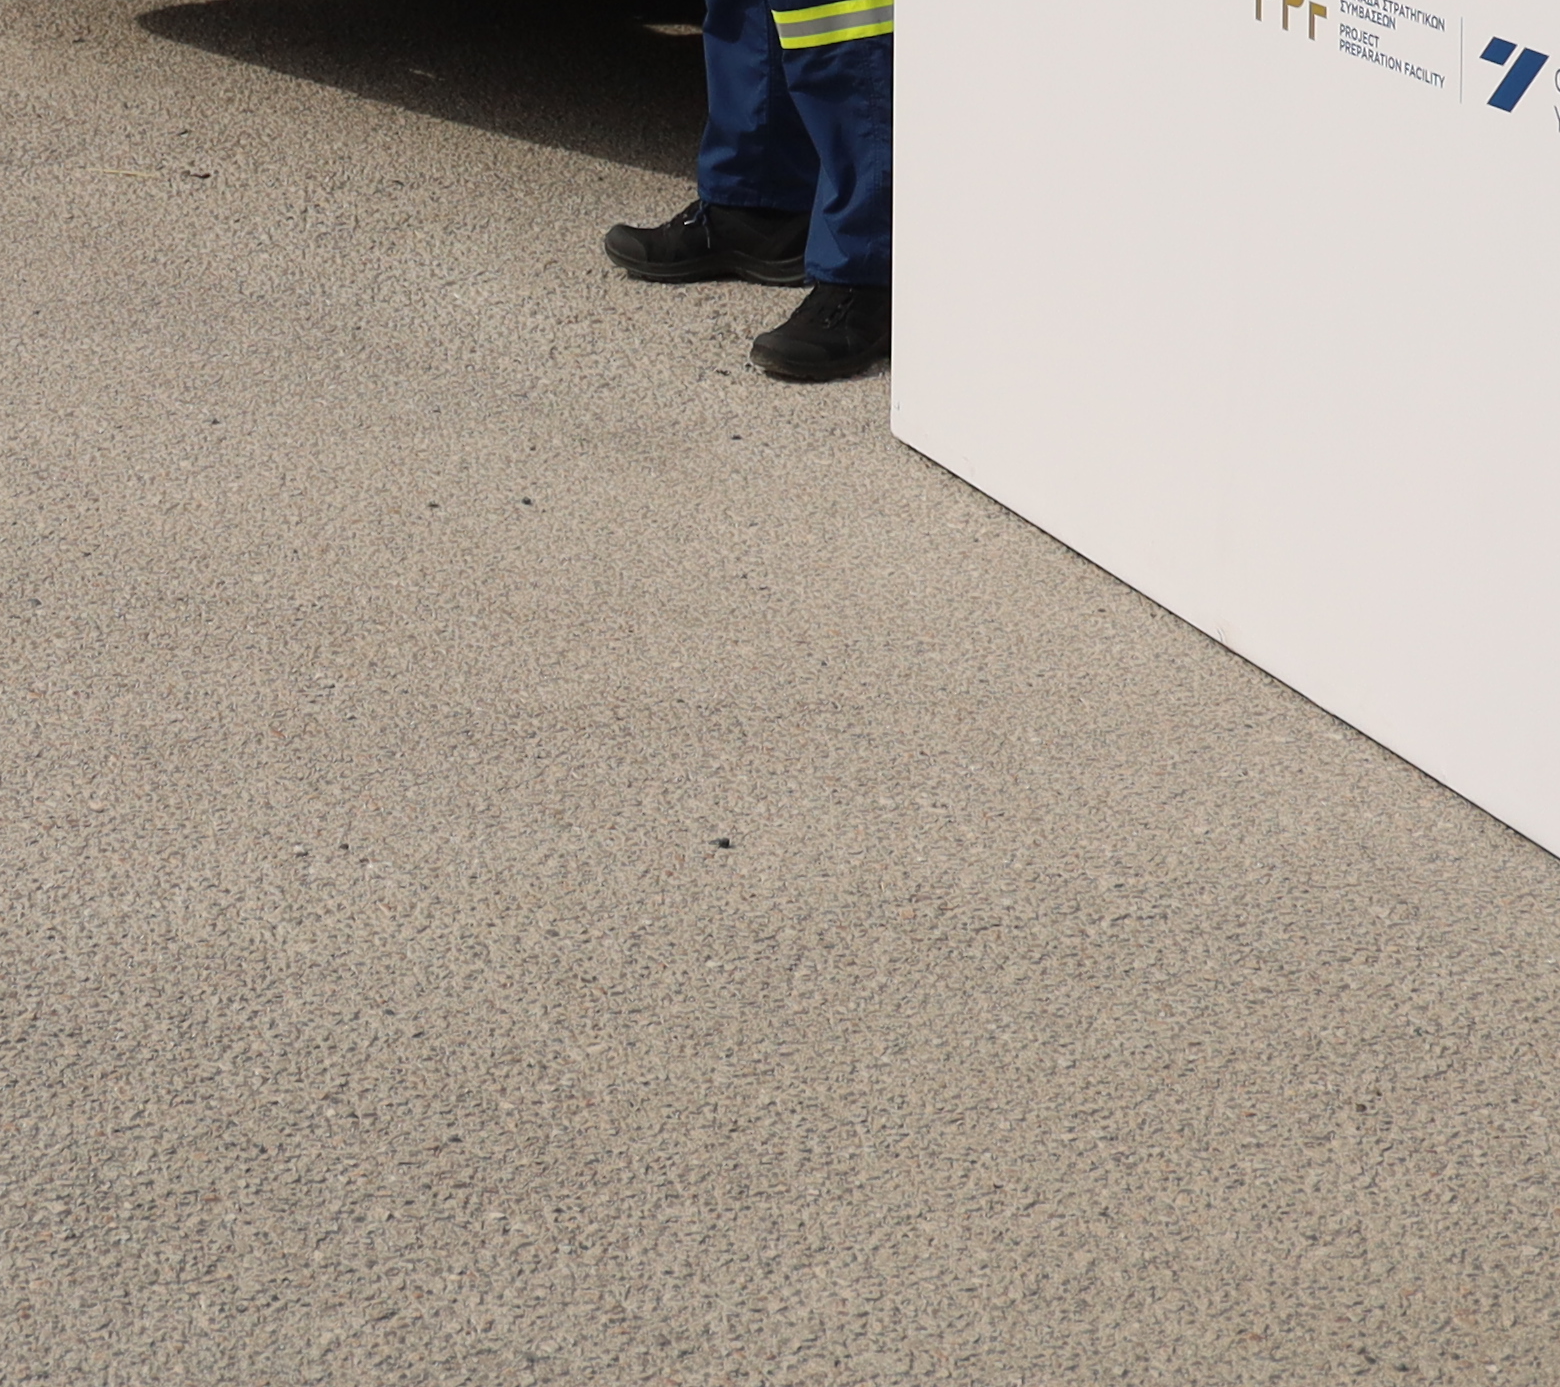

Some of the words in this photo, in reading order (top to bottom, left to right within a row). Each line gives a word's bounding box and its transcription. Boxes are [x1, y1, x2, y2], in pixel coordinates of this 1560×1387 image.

[1339, 0, 1396, 31] ΣΥΜΒΑΣΕΩΝ
[1339, 23, 1380, 49] PROJECT
[1339, 39, 1403, 73] PREPARATION
[1404, 61, 1446, 89] FACILITY
